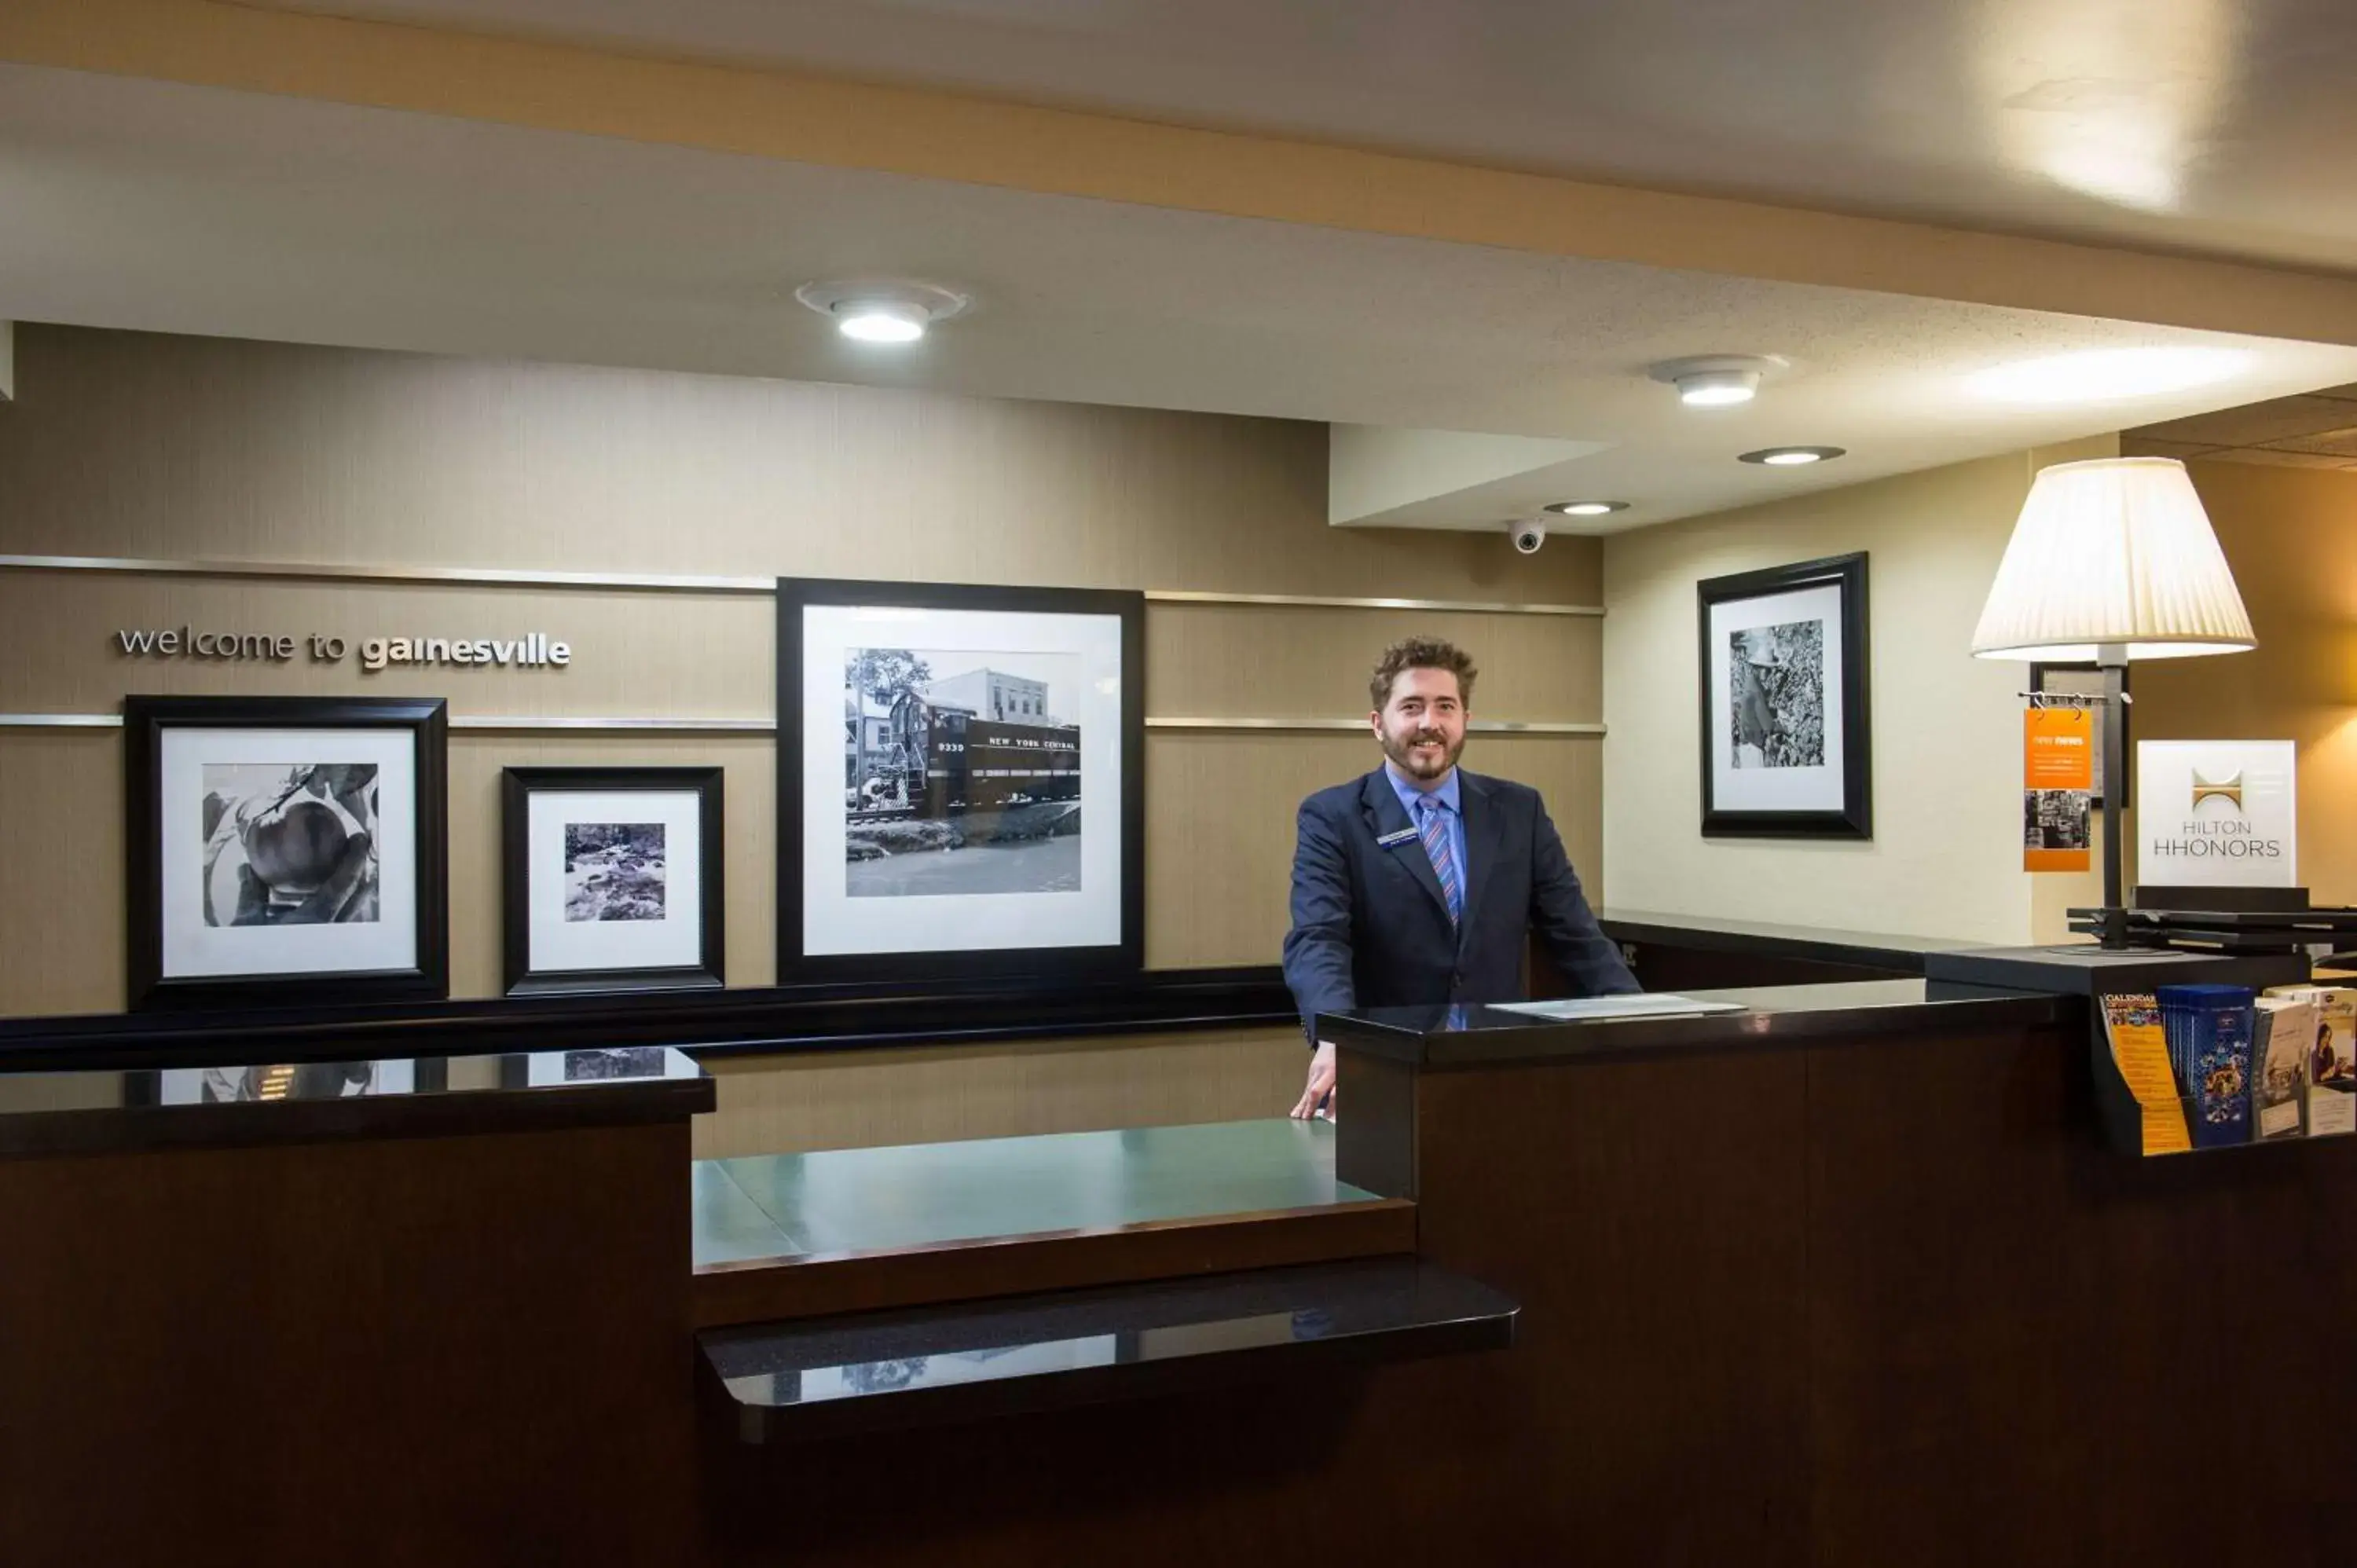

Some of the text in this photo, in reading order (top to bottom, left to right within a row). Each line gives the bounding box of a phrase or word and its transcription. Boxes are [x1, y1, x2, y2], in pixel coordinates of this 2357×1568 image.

[119, 623, 572, 669] welcome to gainesville
[988, 736, 1075, 750] NEW YORK CENTRAL
[2183, 820, 2252, 835] HILTON
[2154, 838, 2281, 857] HHONORS
